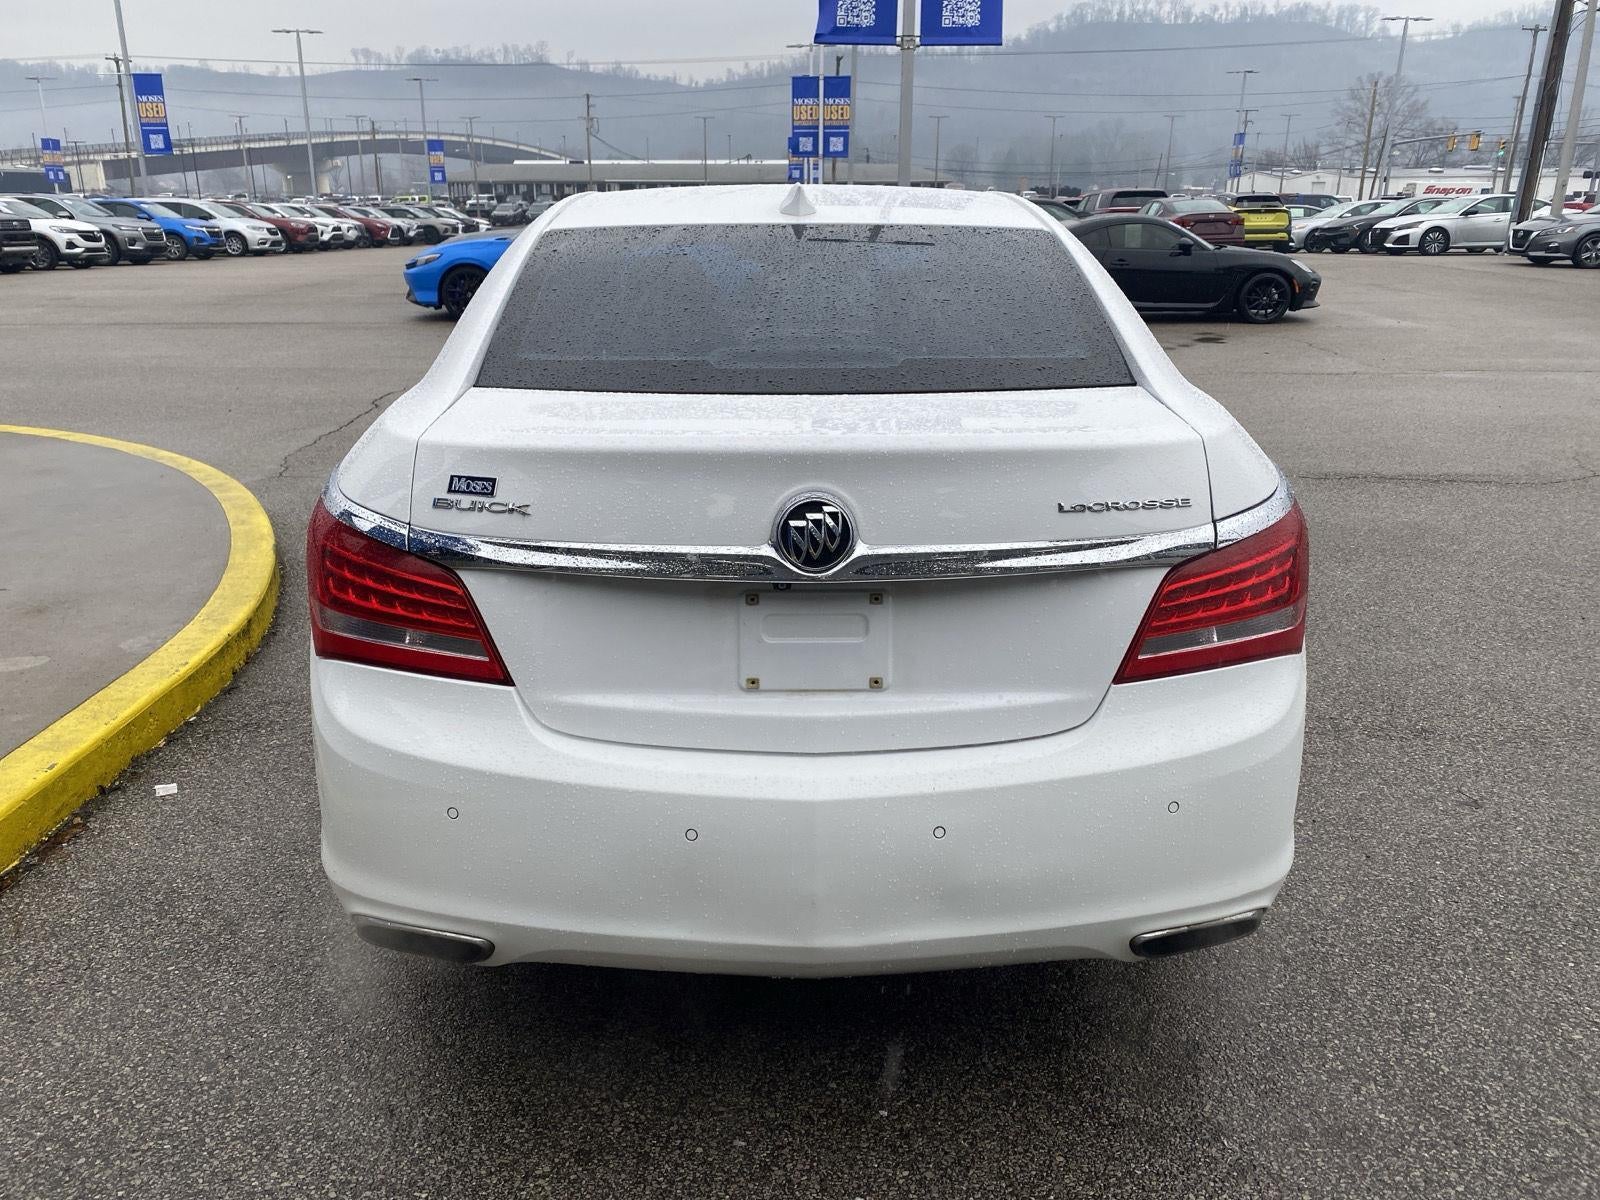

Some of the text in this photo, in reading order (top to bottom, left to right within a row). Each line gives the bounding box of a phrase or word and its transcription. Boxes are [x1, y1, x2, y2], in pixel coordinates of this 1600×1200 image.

[139, 102, 166, 117] USED
[793, 105, 819, 120] USED
[824, 105, 850, 120] USED
[1422, 185, 1473, 196] Snap-on
[451, 477, 493, 493] MOSES
[432, 497, 532, 516] BUICK
